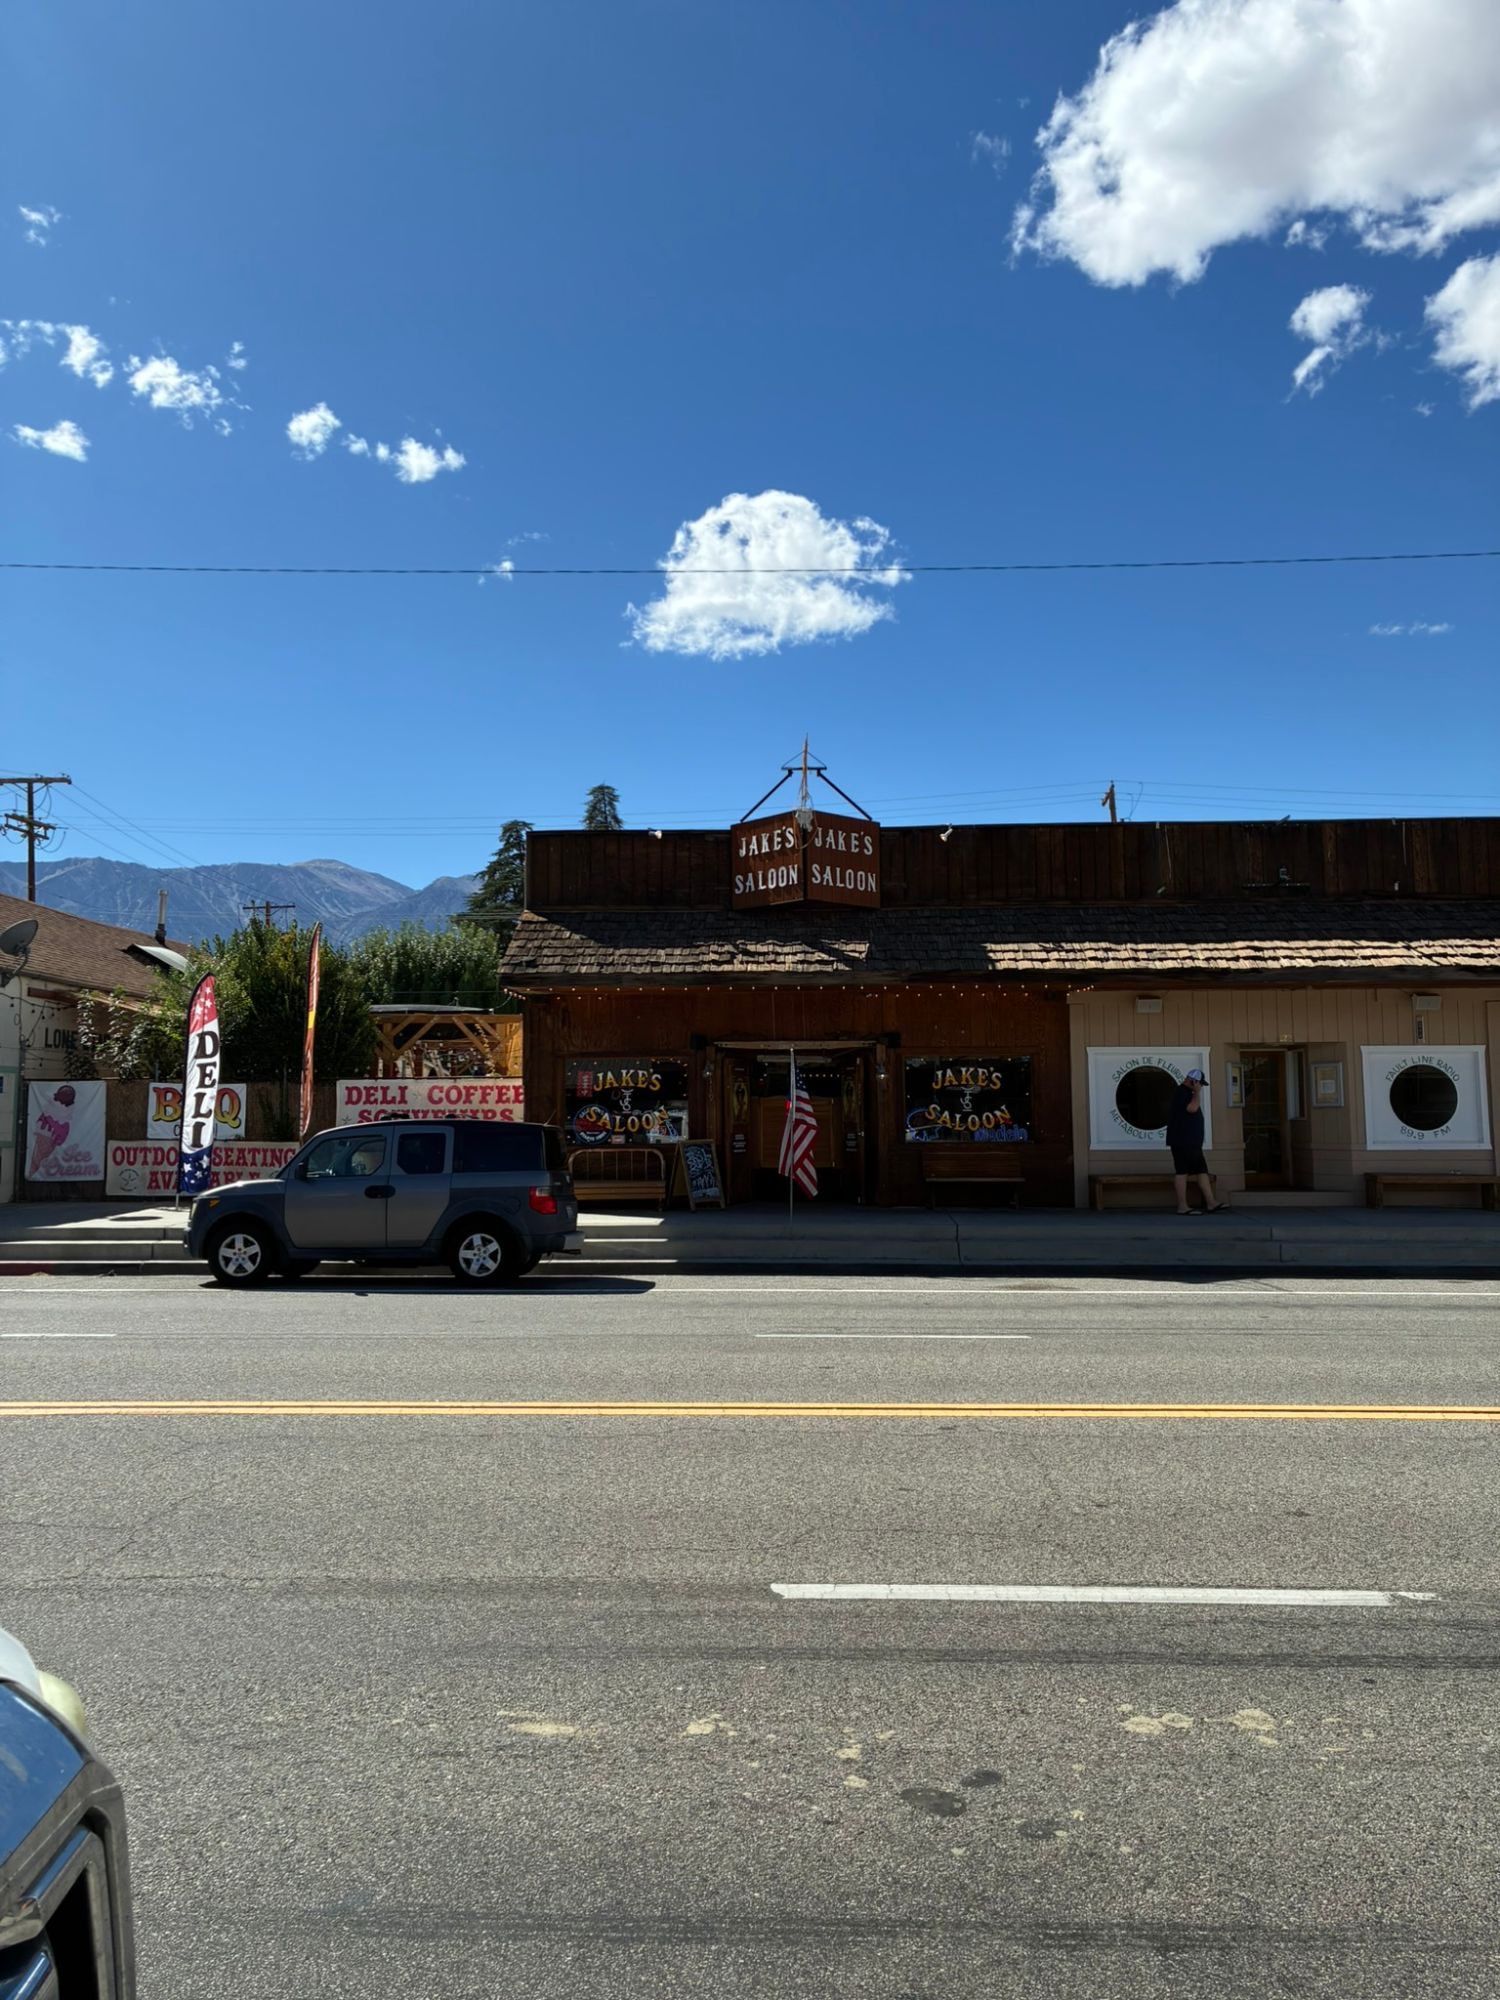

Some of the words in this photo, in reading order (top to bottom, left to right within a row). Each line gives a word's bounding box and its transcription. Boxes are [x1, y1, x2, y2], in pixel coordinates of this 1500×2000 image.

[739, 826, 794, 857] JAKE'S
[814, 827, 873, 855] JAKE'S
[735, 864, 798, 894] SALOON
[812, 864, 876, 892] SALOON
[593, 1068, 662, 1091] JAKE'S
[932, 1067, 1002, 1089] JAKE'S
[1112, 1059, 1140, 1082] SALON
[1142, 1057, 1154, 1065] DE
[1385, 1059, 1408, 1081] FAULT
[1411, 1055, 1434, 1065] LINE
[1436, 1059, 1460, 1082] RADIO
[191, 1031, 220, 1148] DELI
[345, 1086, 408, 1105] DELI
[152, 1087, 241, 1129] BQ
[586, 1105, 669, 1132] SALOON
[925, 1104, 1011, 1131] SALOON
[1109, 1109, 1153, 1140] METABOLIC
[1400, 1125, 1424, 1140] 89.9
[1433, 1125, 1451, 1139] FM
[112, 1147, 179, 1166] OUTDO
[212, 1148, 295, 1168] SEATING
